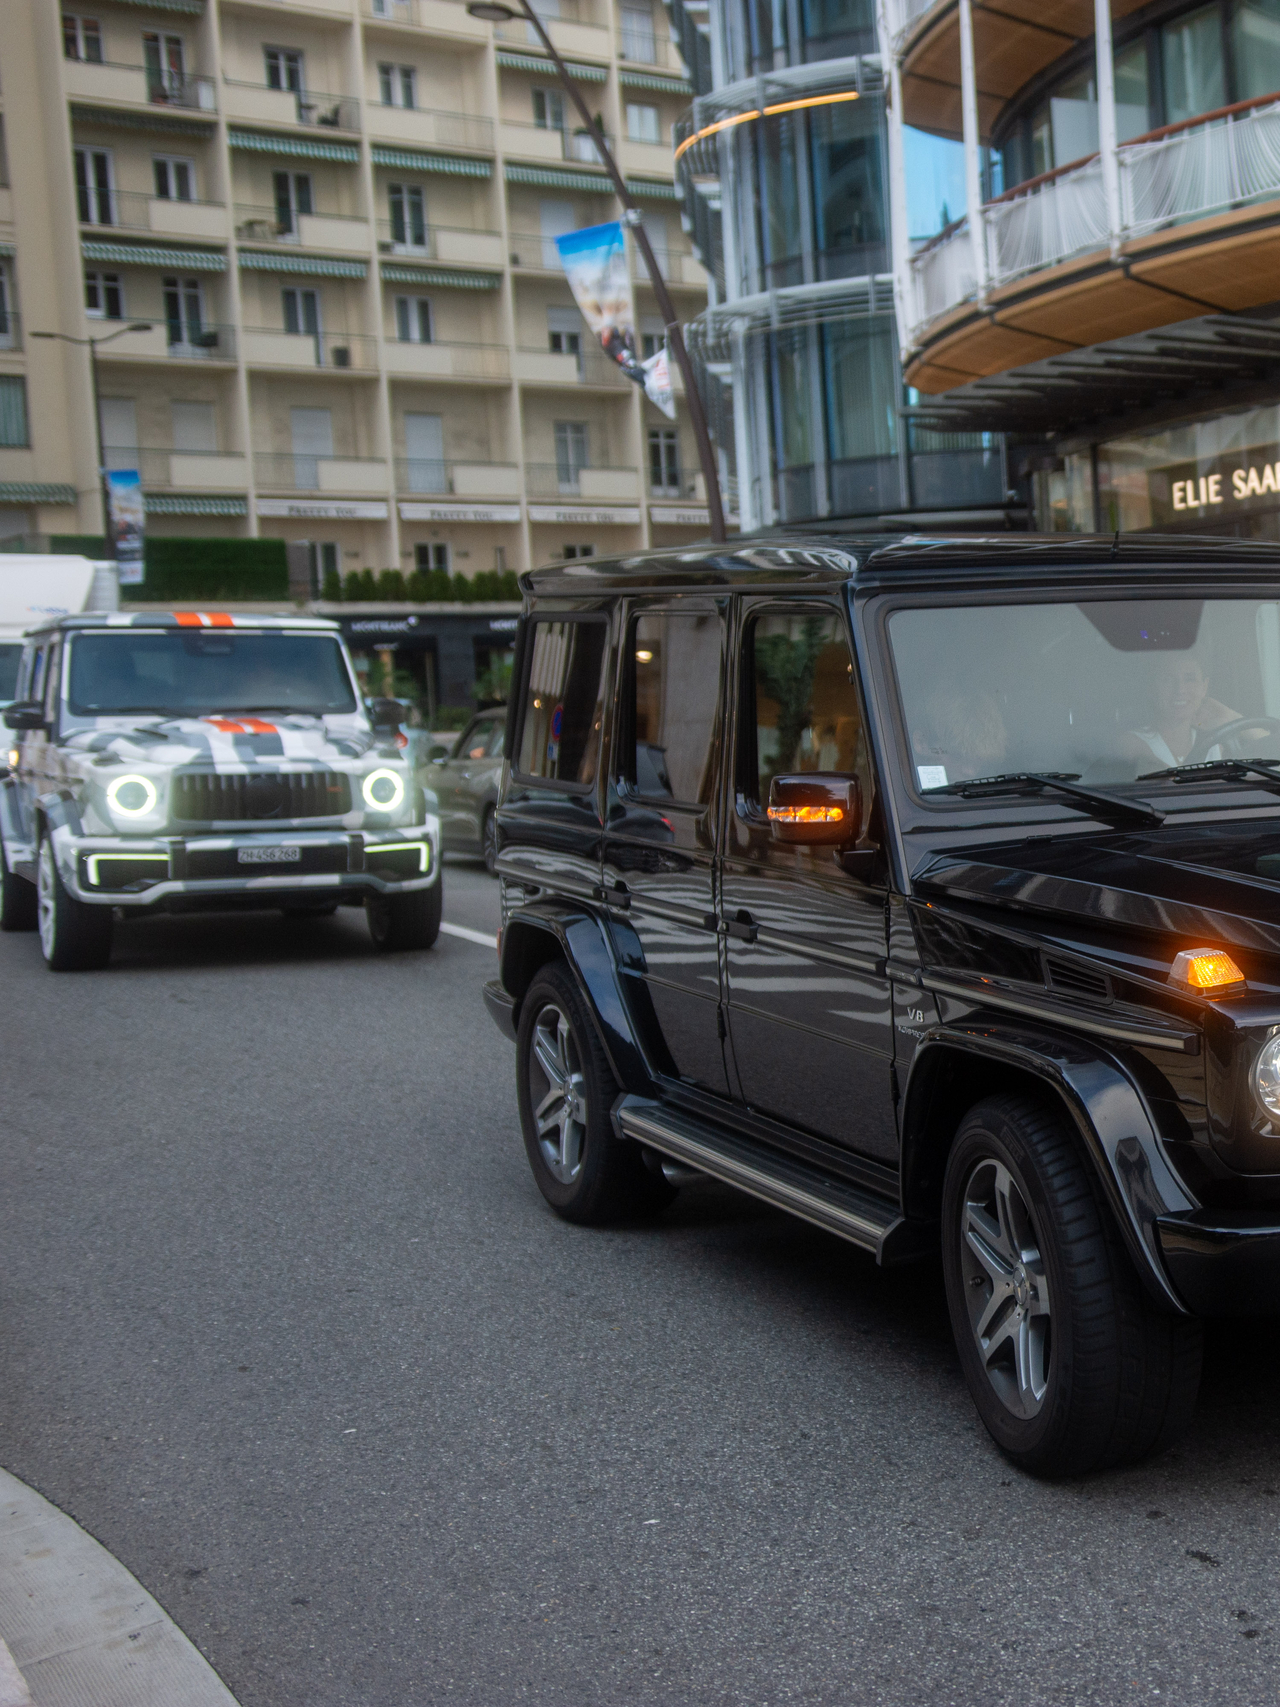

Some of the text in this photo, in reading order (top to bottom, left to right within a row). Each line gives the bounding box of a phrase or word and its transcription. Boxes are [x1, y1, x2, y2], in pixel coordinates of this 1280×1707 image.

[1172, 474, 1224, 511] ELIE
[287, 505, 357, 519] PRETTY YOU
[429, 509, 468, 521] PRETTY
[256, 848, 276, 860] 456
[278, 847, 297, 860] 268
[907, 1006, 924, 1023] V8
